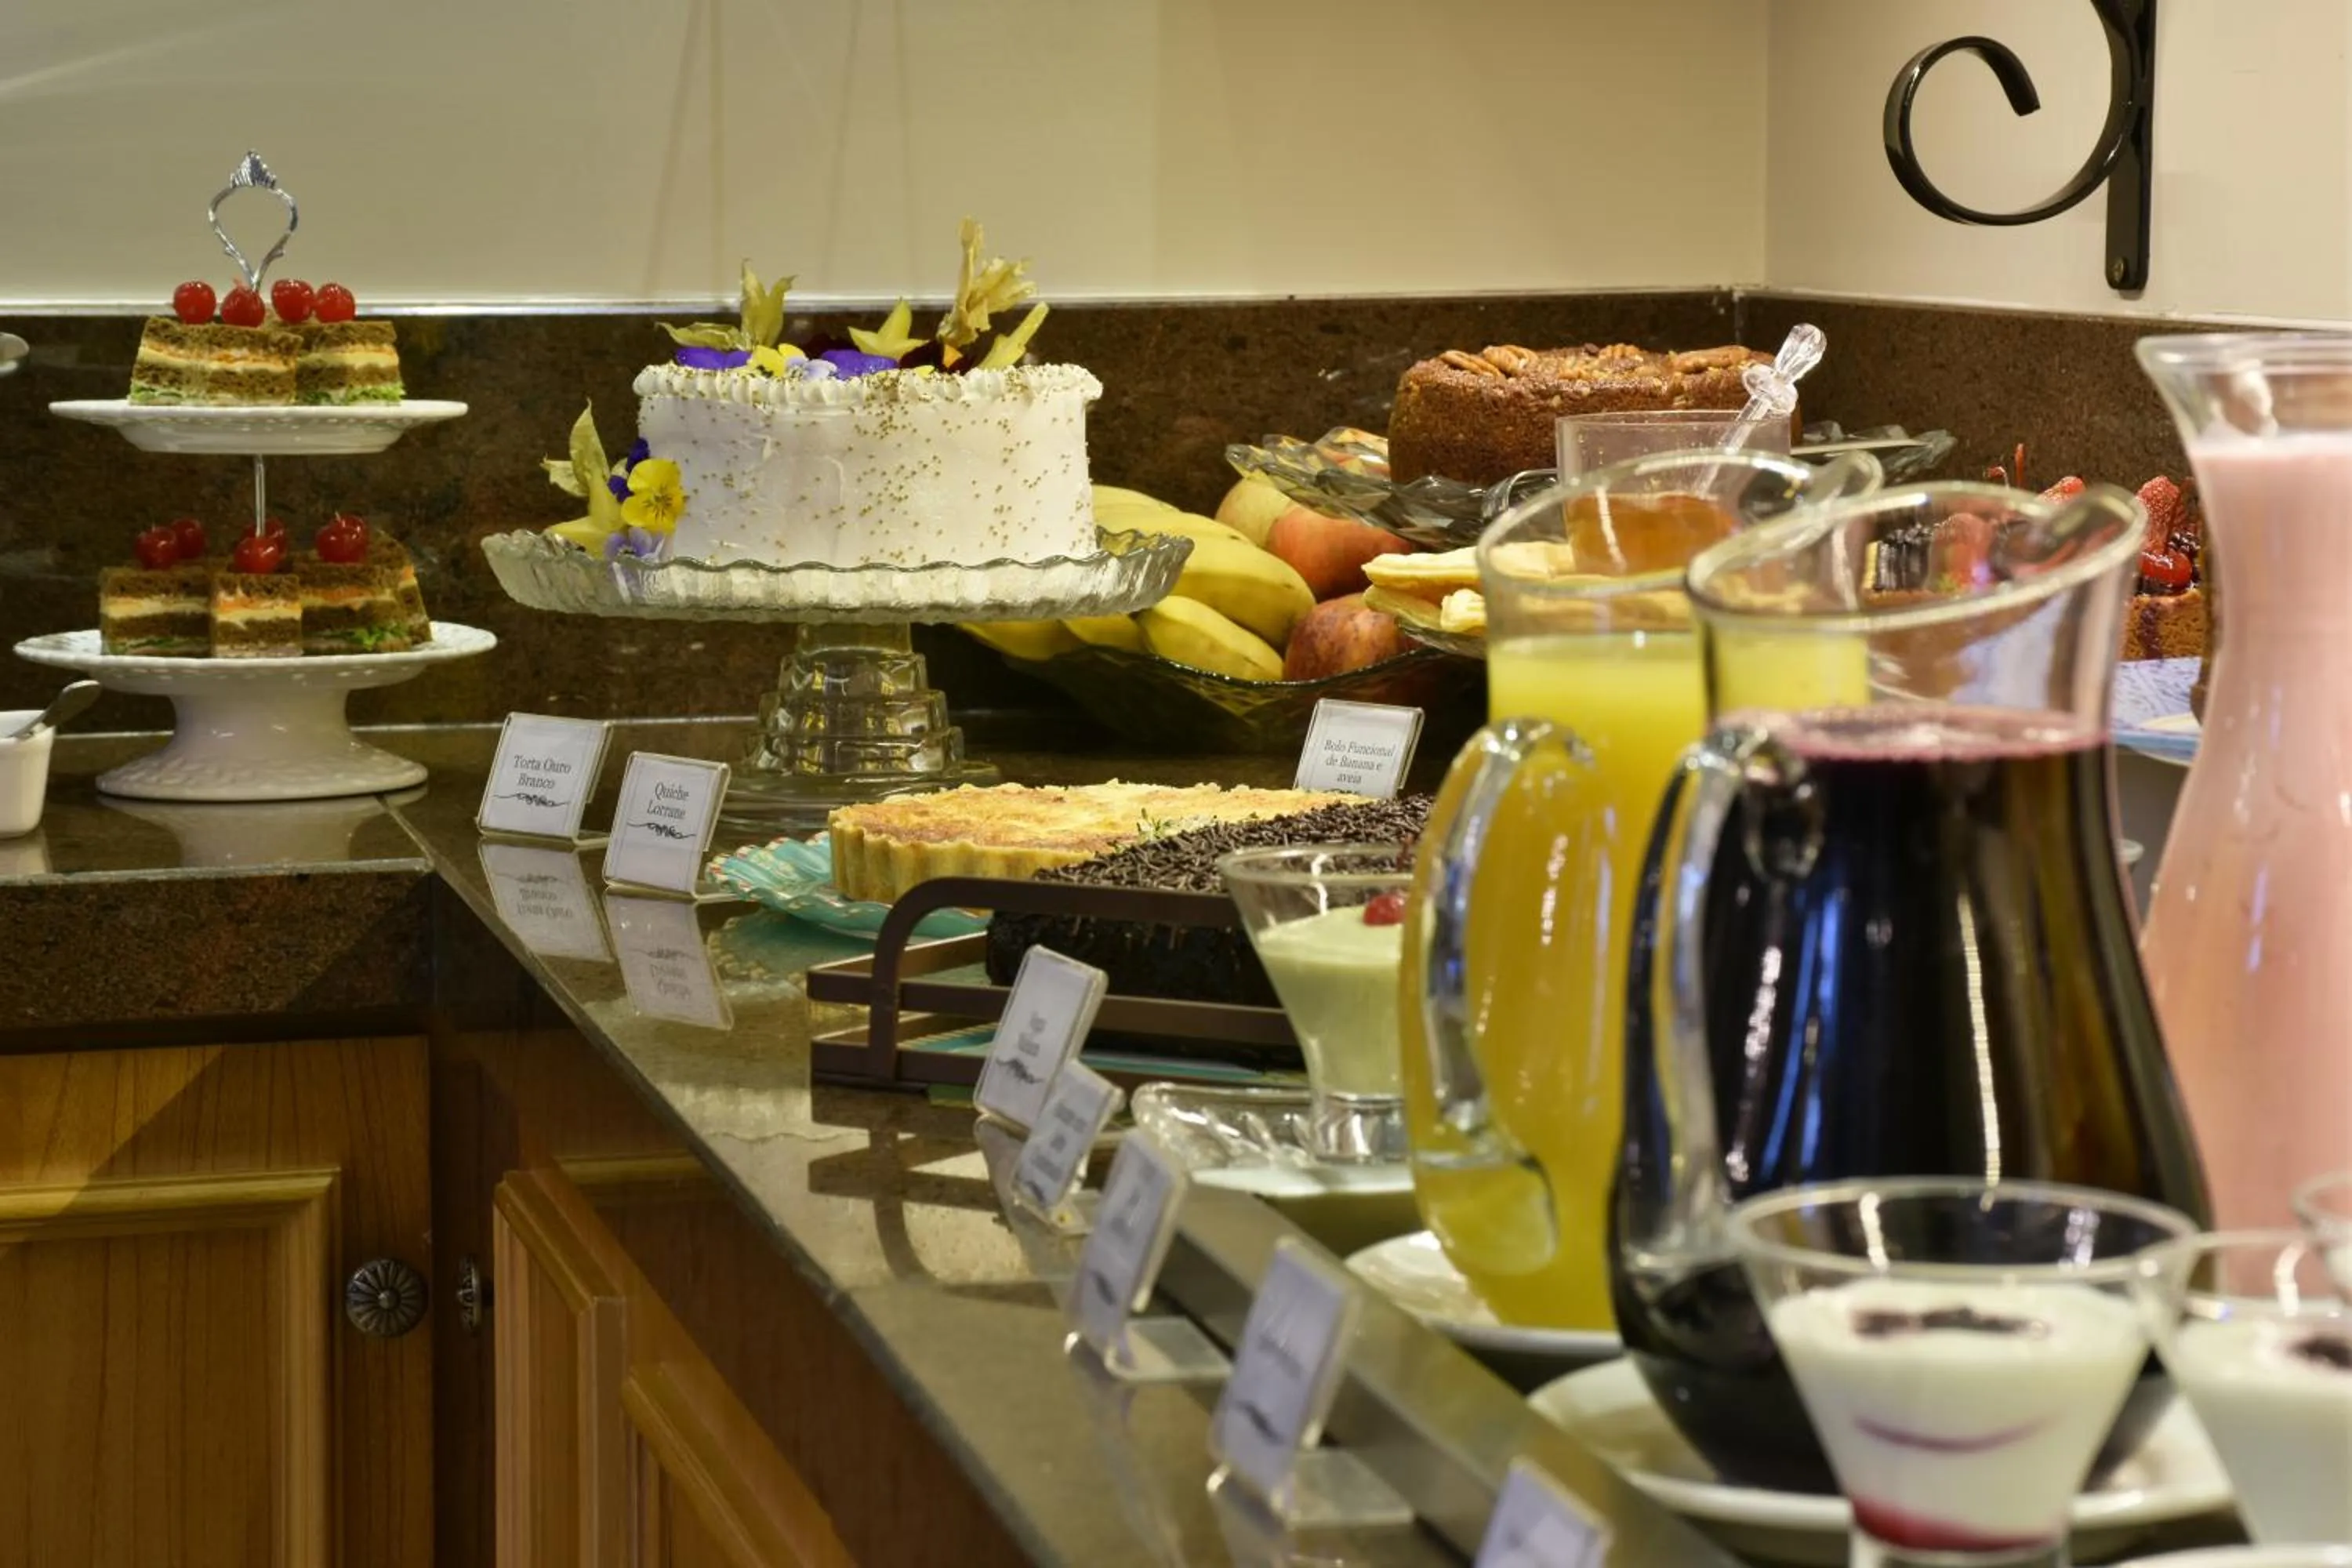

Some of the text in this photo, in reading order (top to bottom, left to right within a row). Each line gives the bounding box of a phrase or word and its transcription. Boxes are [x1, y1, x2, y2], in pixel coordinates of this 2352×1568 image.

[1324, 739, 1396, 757] Bolo Funcional
[514, 754, 541, 771] Torta
[1326, 753, 1338, 766] de
[1340, 756, 1374, 771] Banana
[517, 773, 556, 789] Branco
